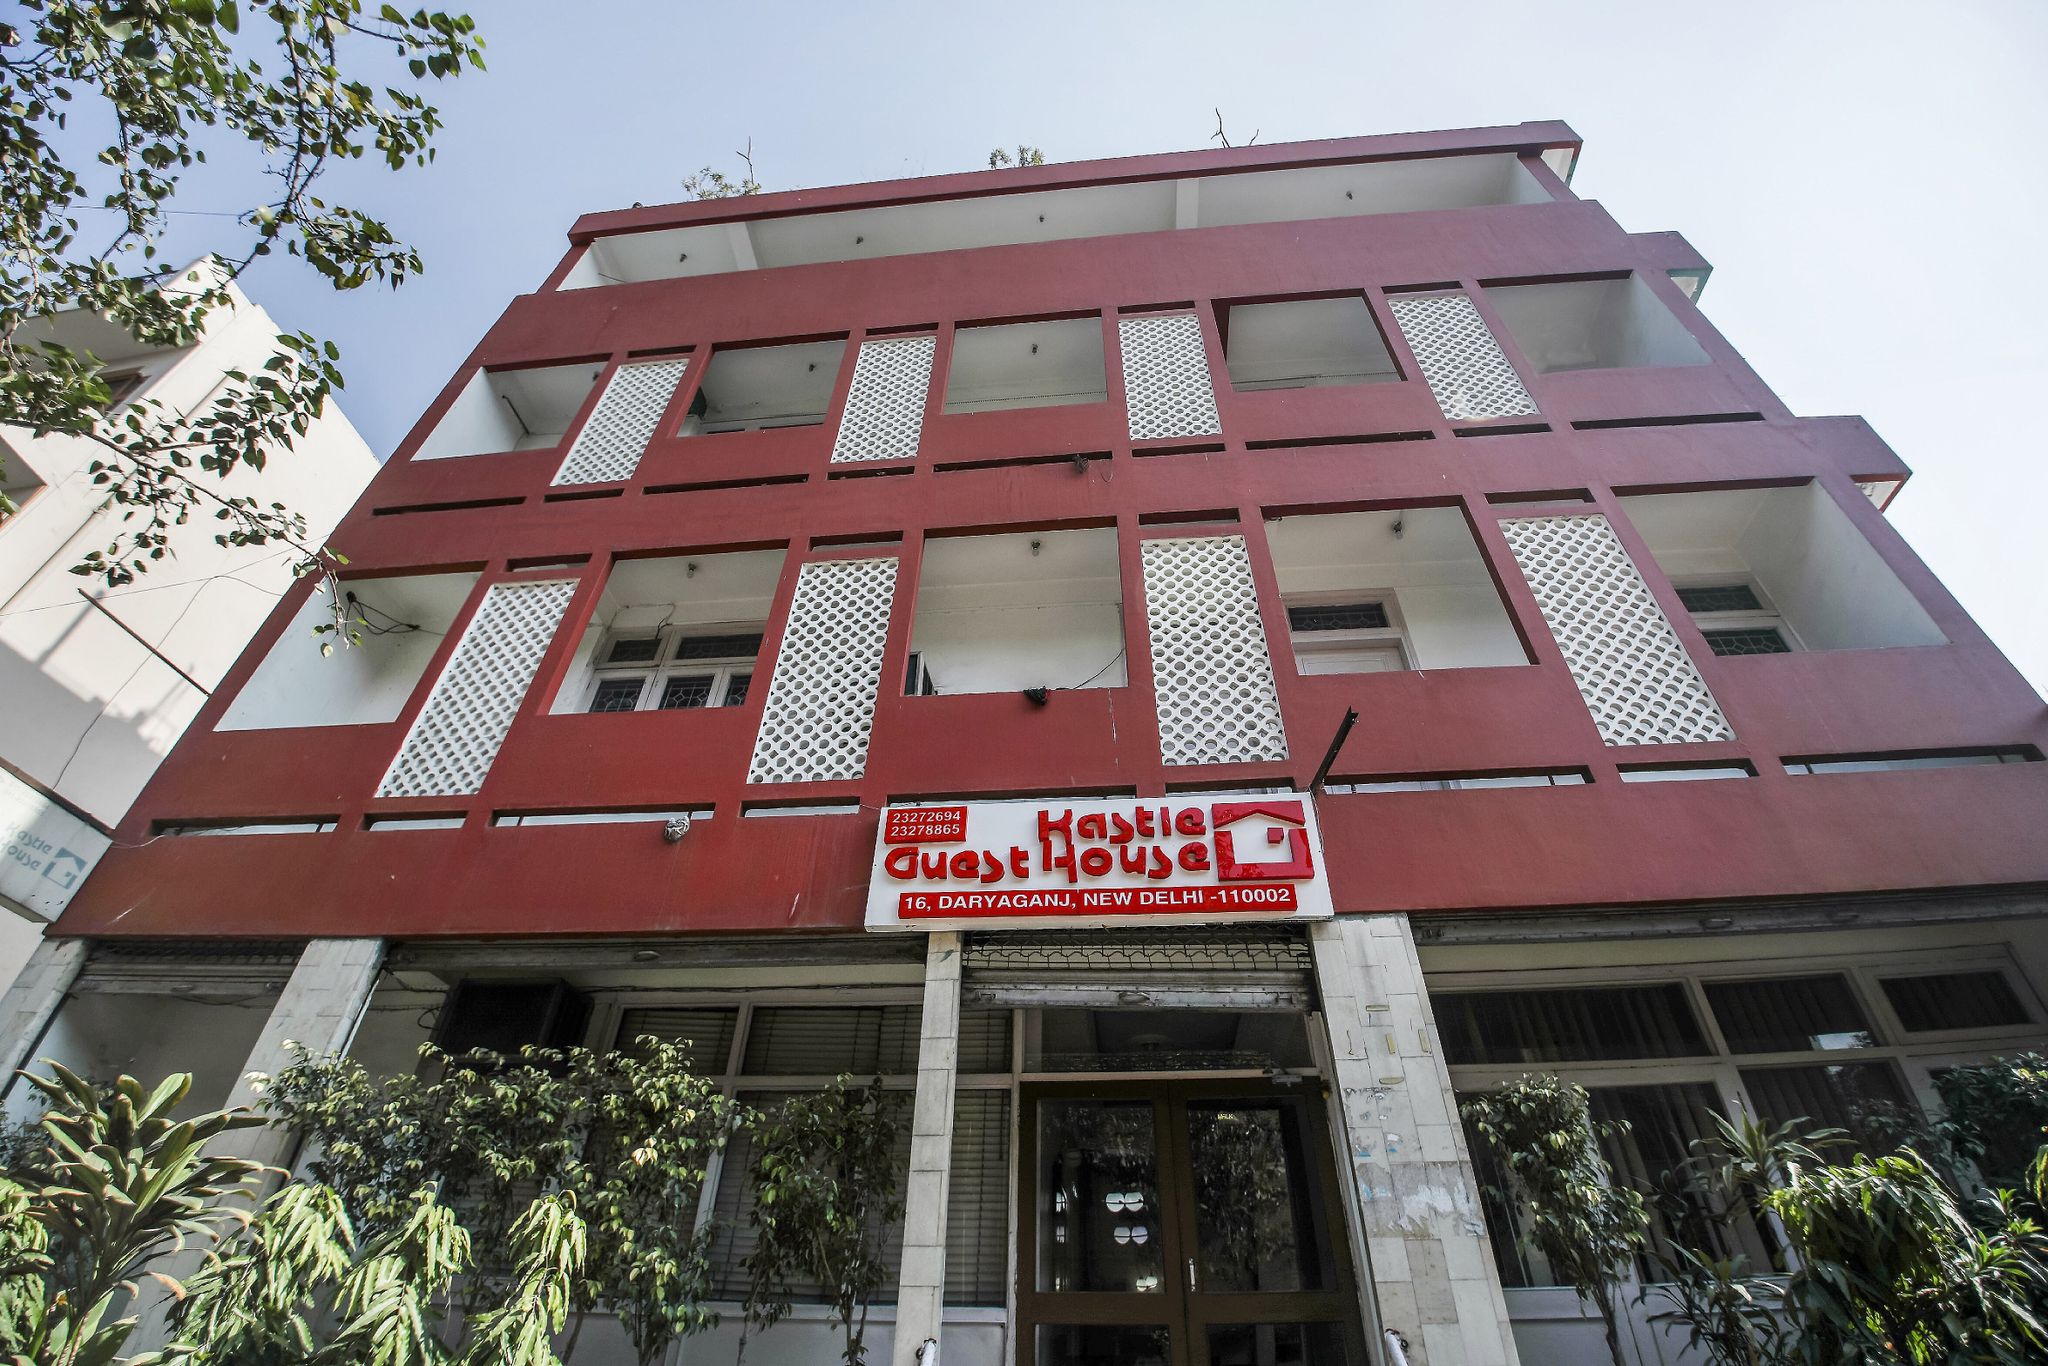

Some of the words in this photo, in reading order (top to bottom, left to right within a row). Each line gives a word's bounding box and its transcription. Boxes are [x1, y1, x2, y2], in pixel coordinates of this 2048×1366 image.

[892, 811, 961, 824] 23272694
[1038, 806, 1207, 844] Kastle
[890, 824, 961, 837] 23278865
[884, 846, 1030, 884] Guest
[1042, 839, 1211, 883] House
[904, 896, 932, 912] 16,
[938, 893, 1077, 909] DARYAGANJ,
[1083, 892, 1133, 906] NEW
[1139, 889, 1204, 905] DELHI
